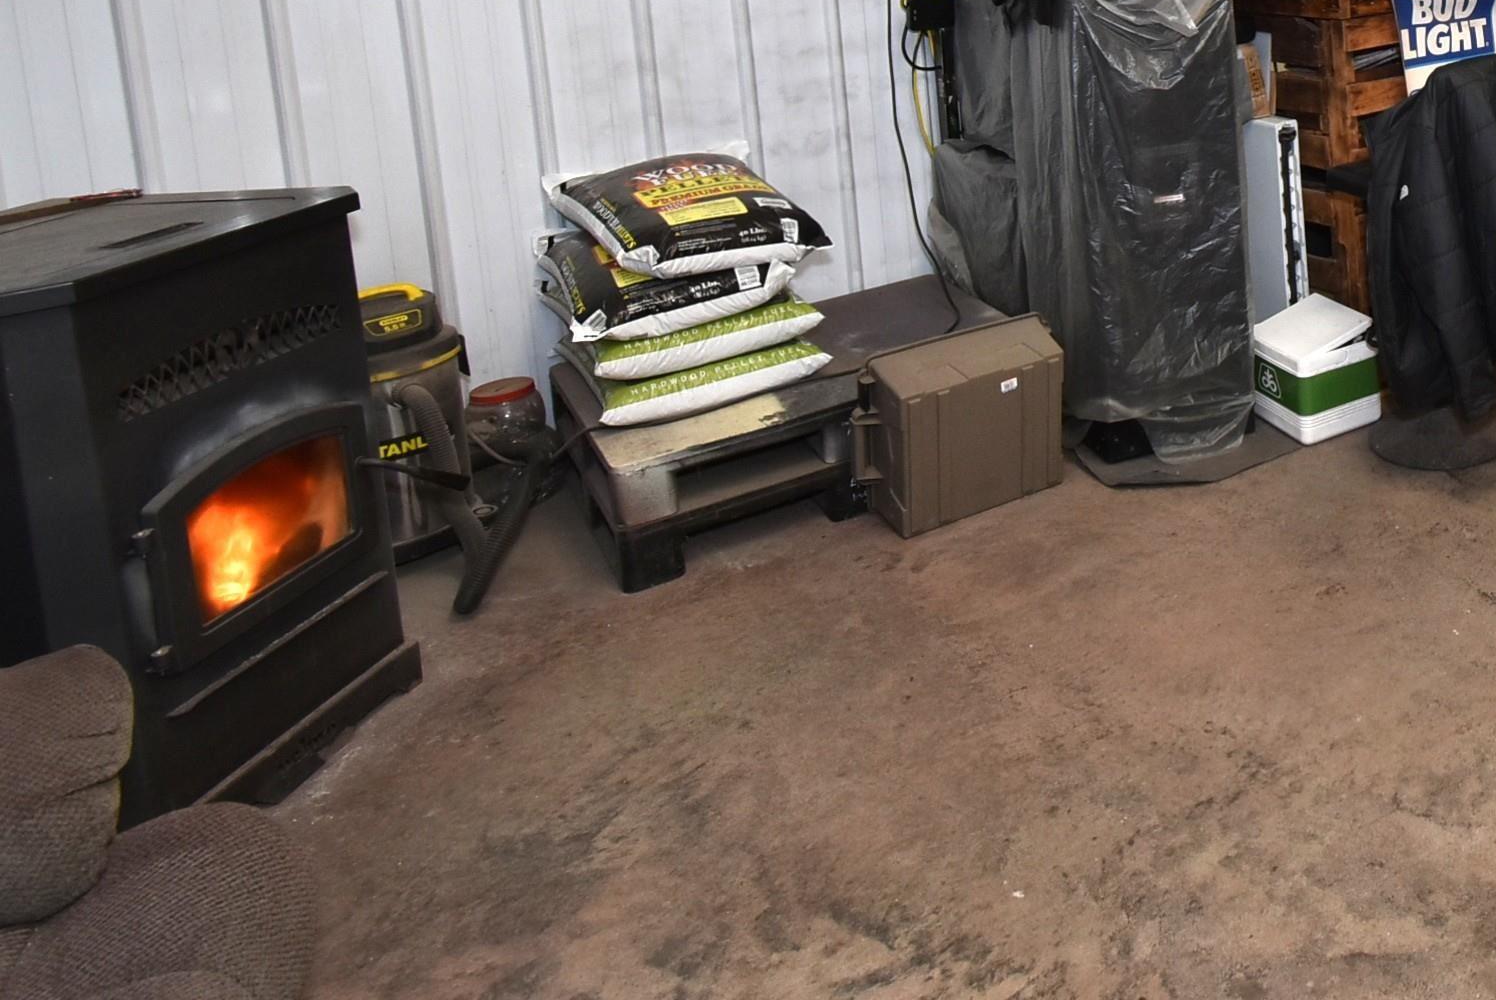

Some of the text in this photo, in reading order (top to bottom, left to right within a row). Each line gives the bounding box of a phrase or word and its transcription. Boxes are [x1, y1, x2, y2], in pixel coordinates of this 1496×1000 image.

[1400, 17, 1488, 61] LIGHT
[633, 163, 738, 182] WOOD
[651, 187, 722, 206] PREMIUM
[623, 328, 699, 350] HARDWOOD
[630, 369, 707, 397] HARDWOOD
[378, 435, 429, 459] TANL
